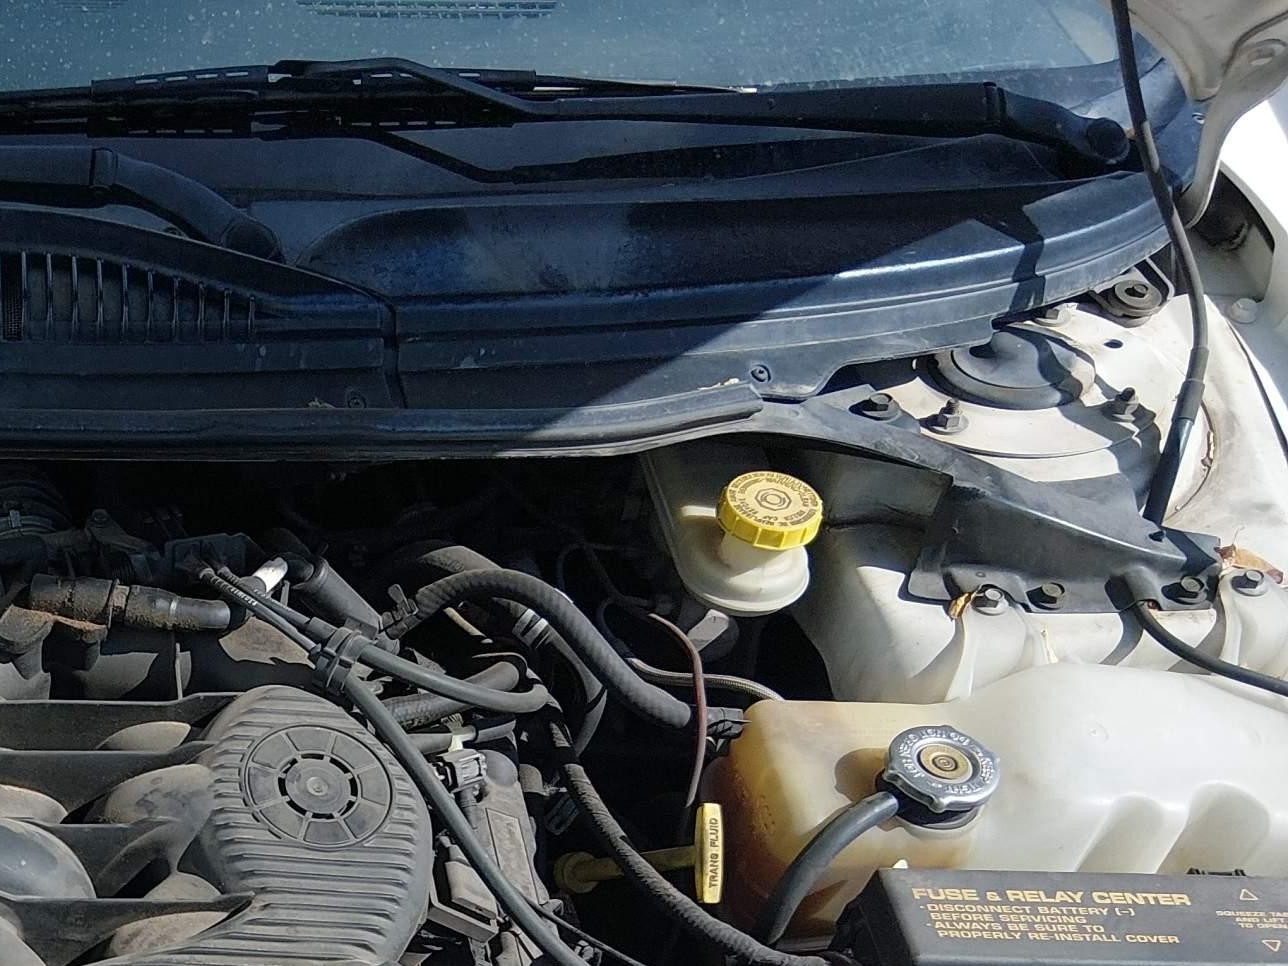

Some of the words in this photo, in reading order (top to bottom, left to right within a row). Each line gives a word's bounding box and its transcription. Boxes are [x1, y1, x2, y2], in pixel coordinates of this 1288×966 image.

[708, 817, 719, 848] FLUID
[912, 888, 979, 901] FUSE
[986, 891, 1001, 901] &
[1006, 889, 1083, 903] RELAY
[1092, 892, 1191, 906] CENTER
[926, 903, 1031, 914] DISCONNECT
[1038, 907, 1108, 916] BATTERY
[931, 912, 994, 922] BEFORE
[998, 914, 1088, 924] SERVICING
[934, 921, 1003, 931] ALWAYS
[1007, 924, 1029, 932] BE
[1034, 924, 1079, 933] SURE
[1083, 925, 1105, 933] TO
[937, 930, 1022, 940] PROPERLY
[1027, 932, 1122, 942] RE-INSTALL
[1125, 934, 1181, 944] COVER
